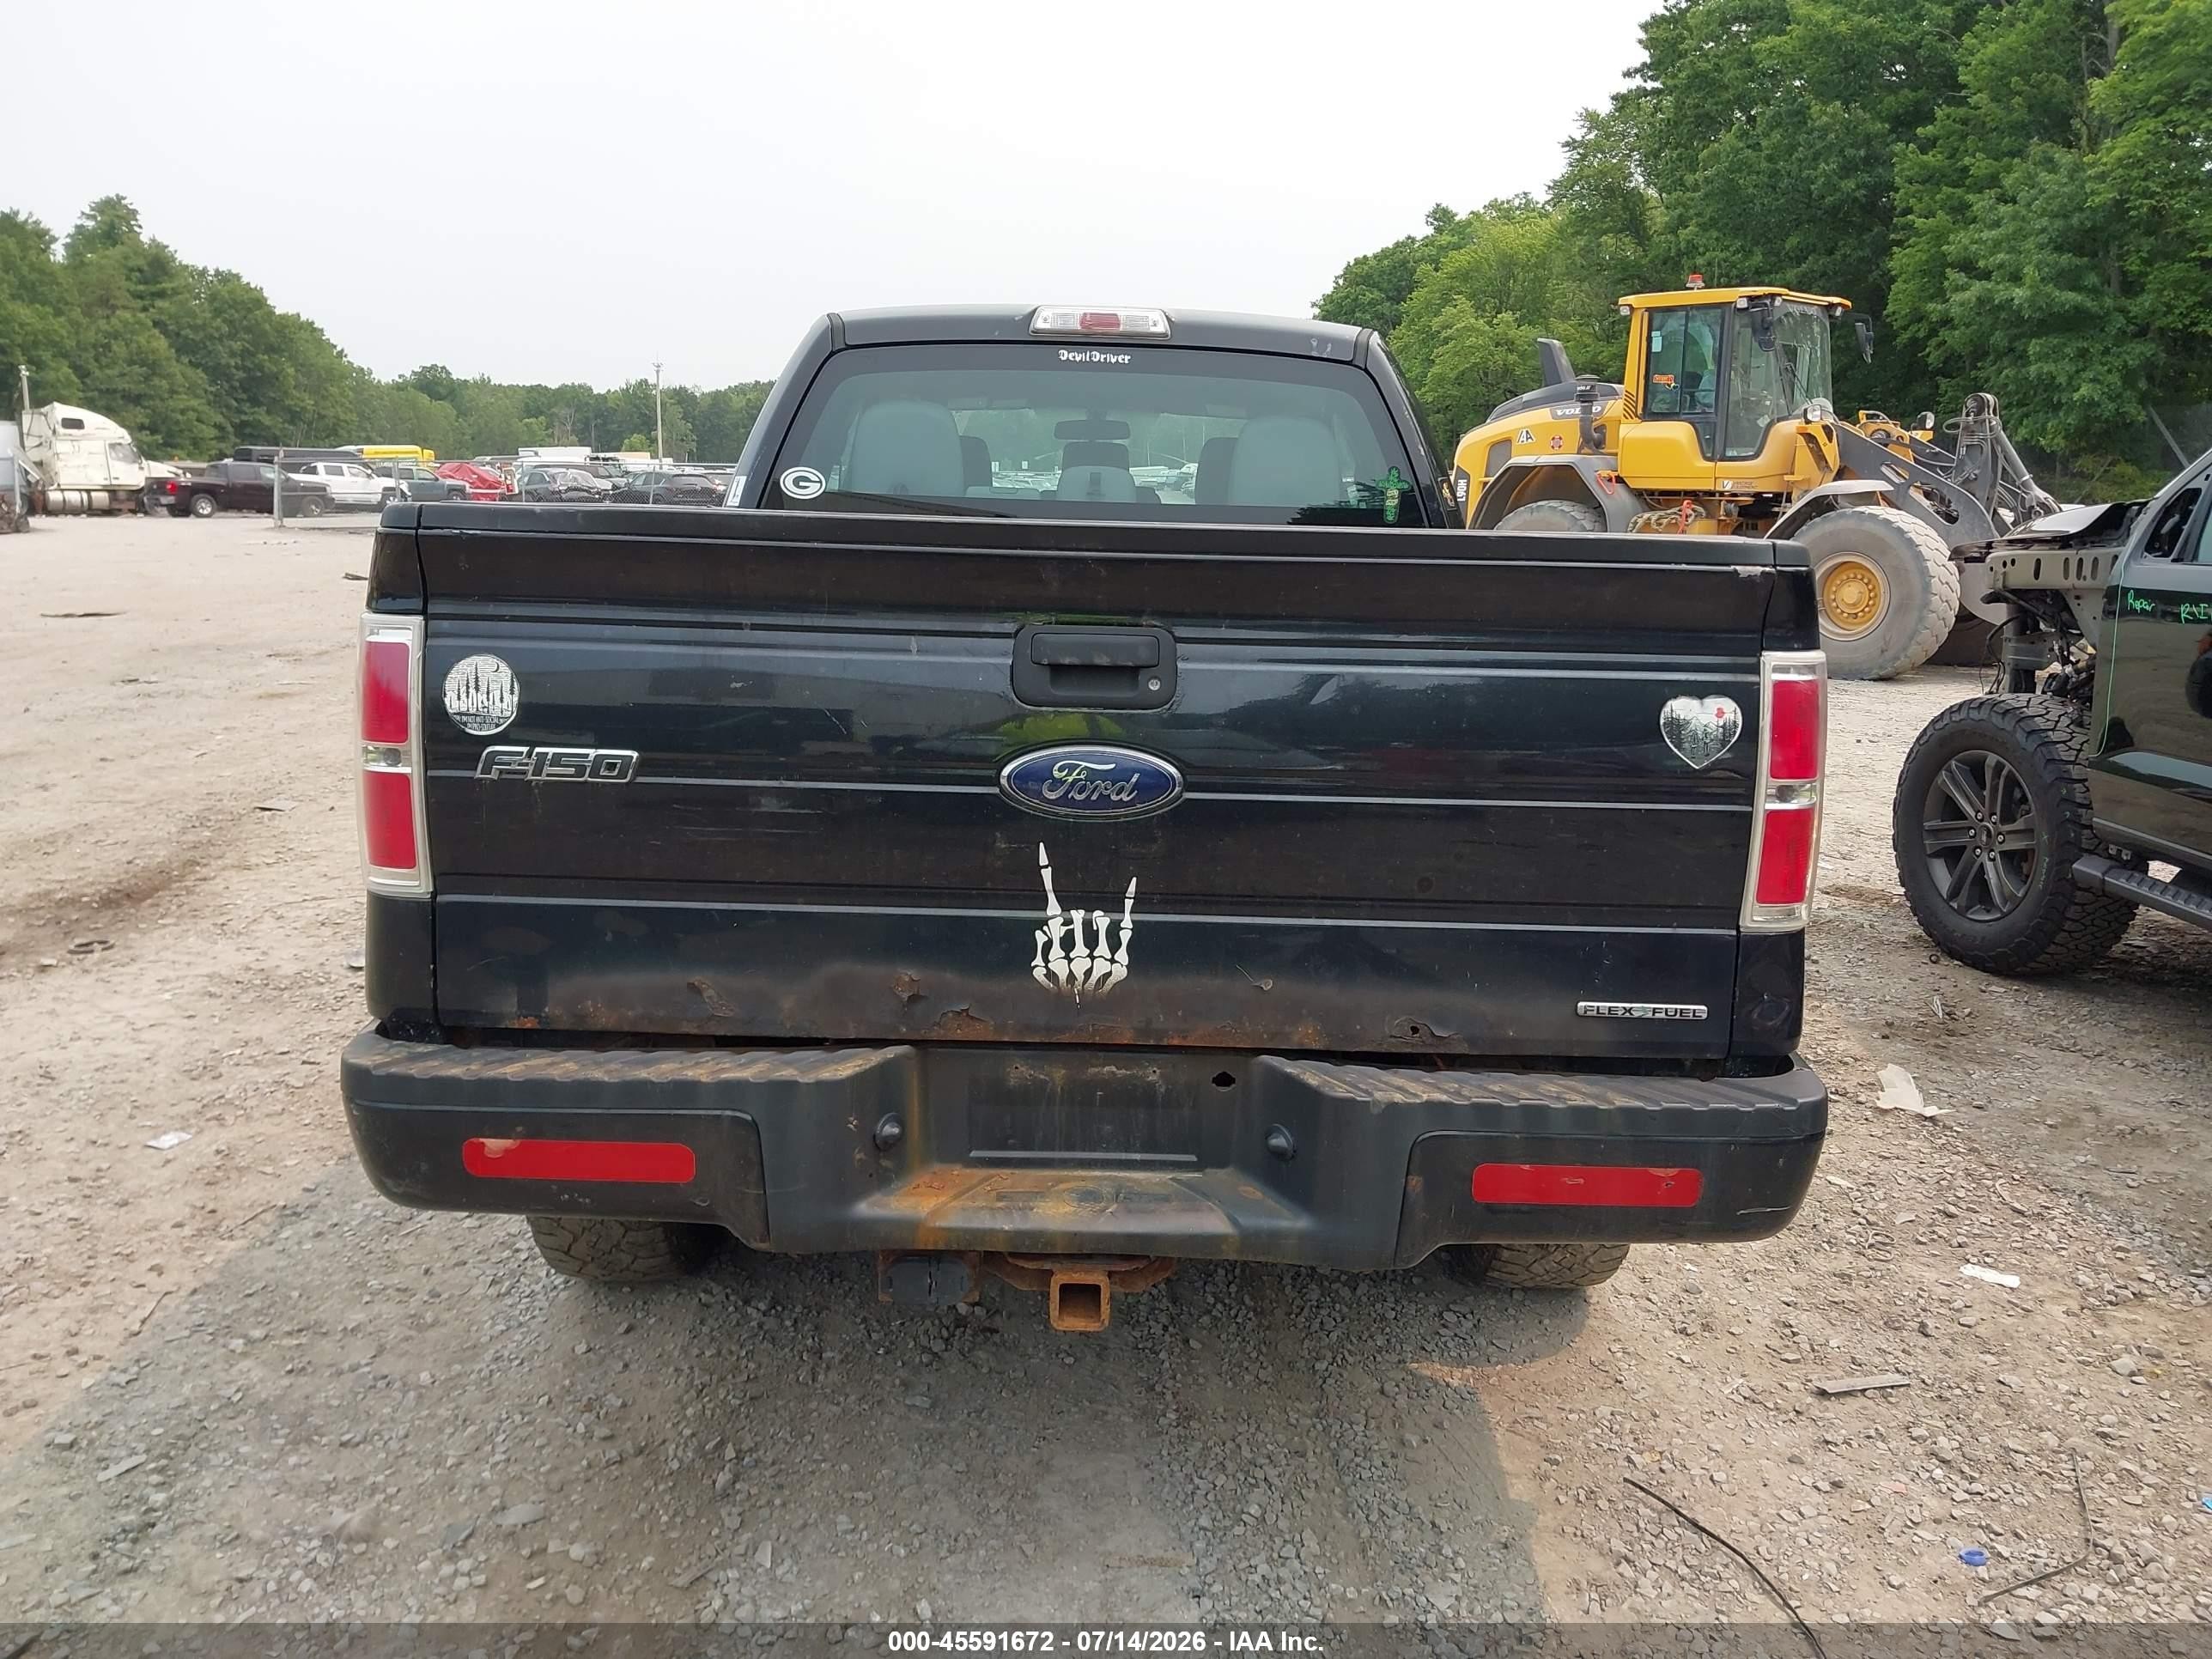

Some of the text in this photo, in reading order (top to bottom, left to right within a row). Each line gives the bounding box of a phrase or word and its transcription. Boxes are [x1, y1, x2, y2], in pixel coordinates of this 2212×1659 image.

[1556, 405, 1602, 416] VOLO
[783, 470, 822, 495] G
[1456, 479, 1468, 502] L90H
[2127, 589, 2156, 615] Repair
[1042, 760, 1139, 802] Ford
[1583, 1005, 1706, 1018] FLEX FUEL
